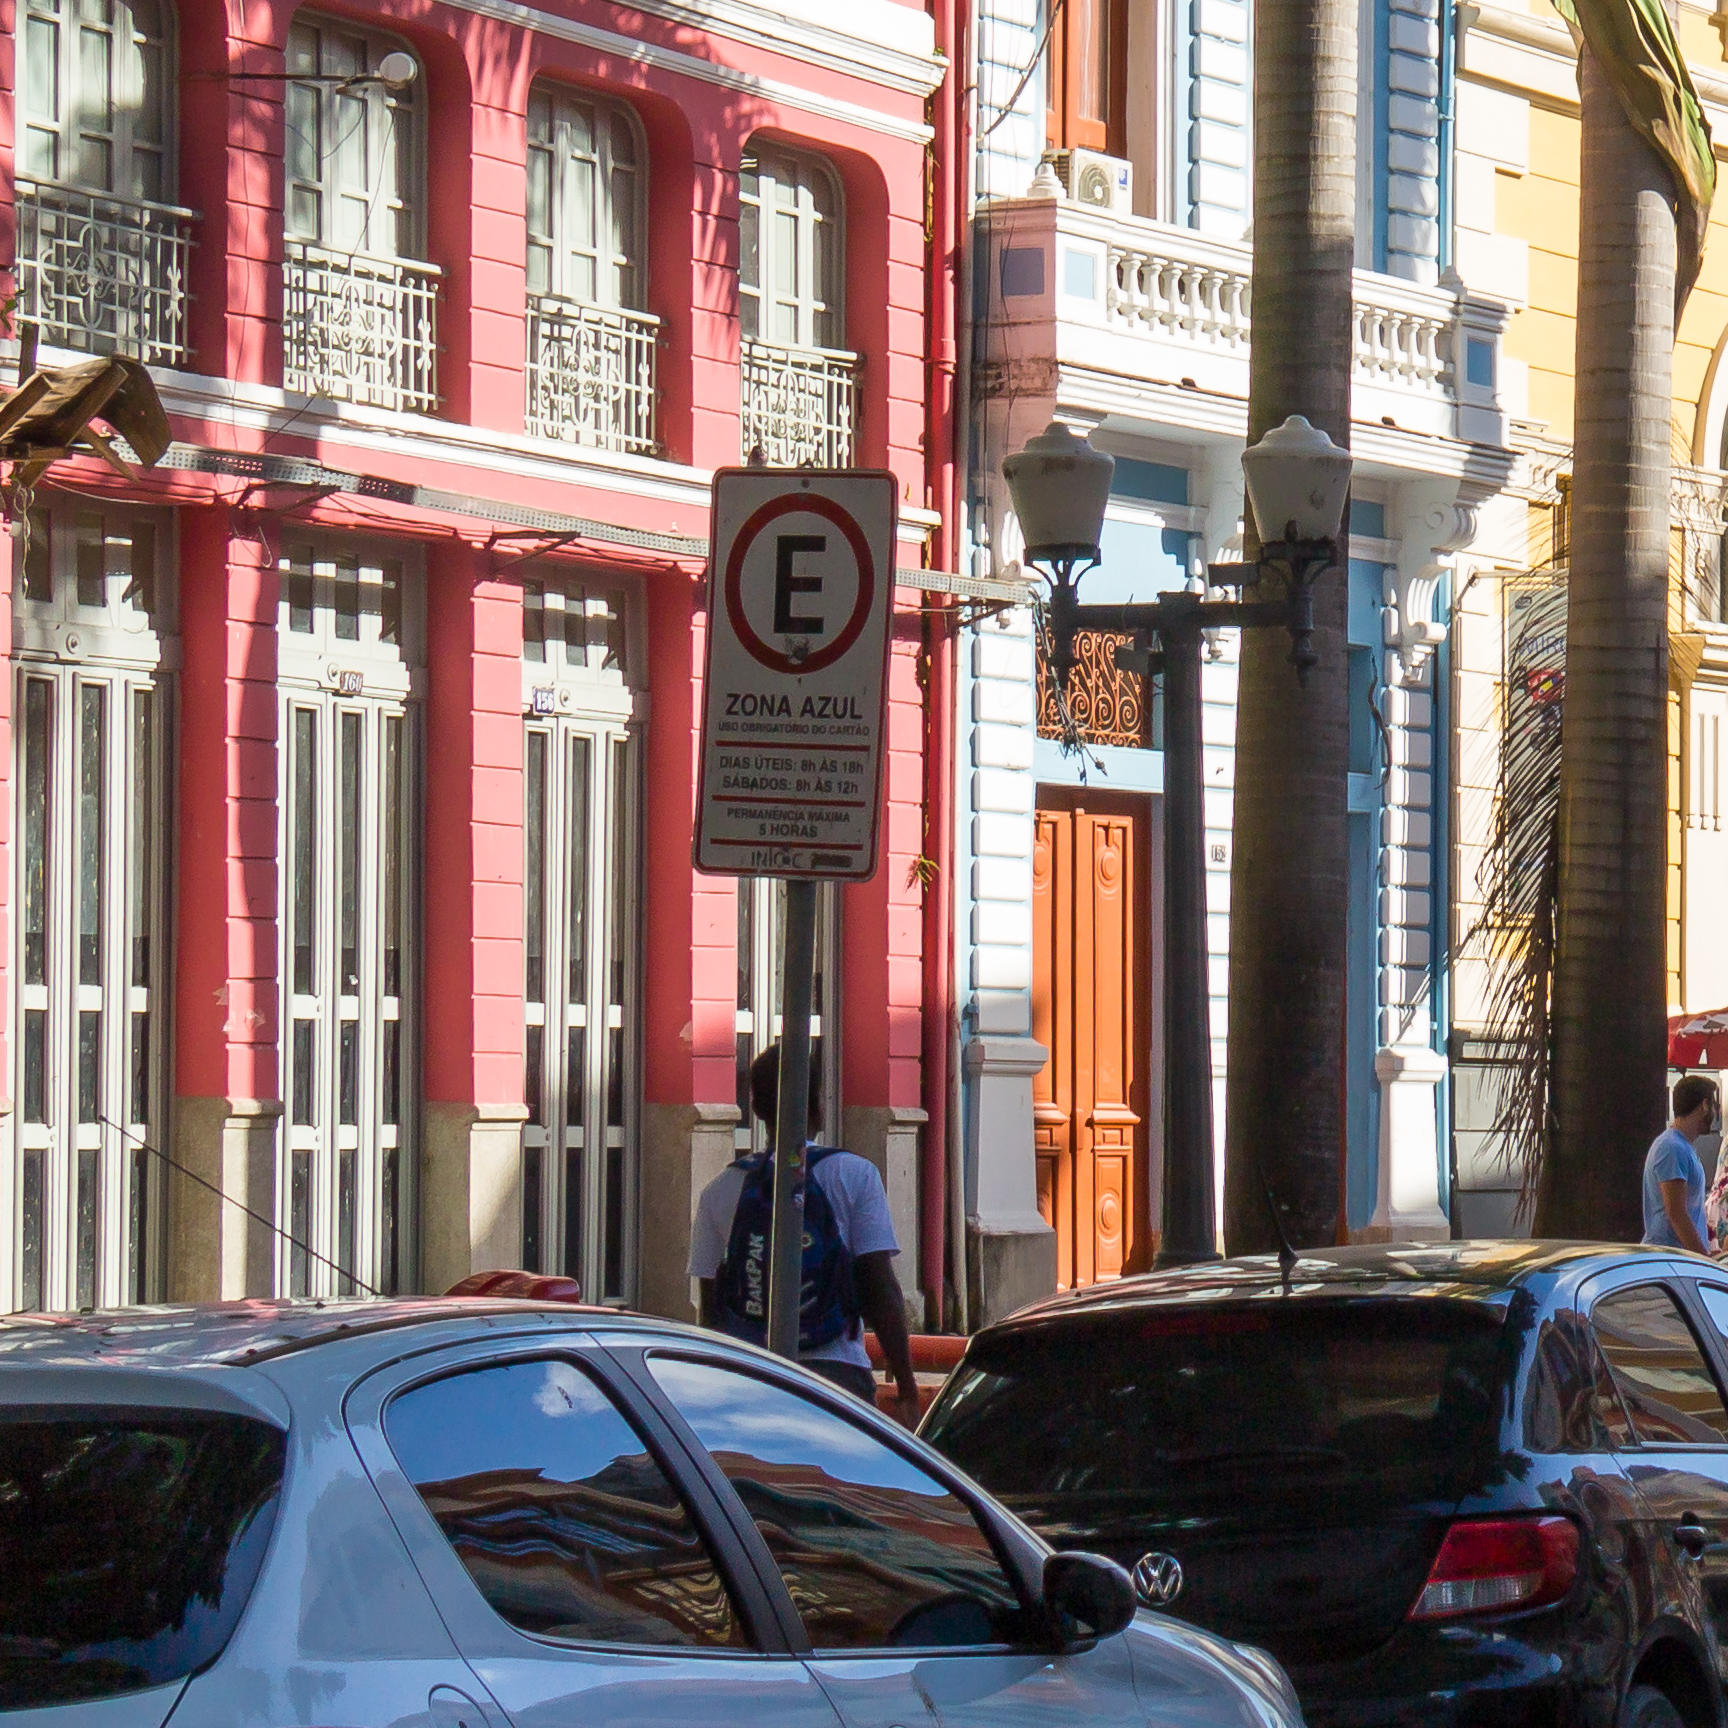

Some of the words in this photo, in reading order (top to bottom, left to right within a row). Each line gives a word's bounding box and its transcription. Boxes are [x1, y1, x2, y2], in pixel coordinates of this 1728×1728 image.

[773, 535, 827, 635] E
[725, 693, 792, 718] ZONA
[799, 696, 863, 719] AZUL
[718, 722, 738, 732] USO
[741, 722, 809, 734] OBRIGATÓRIO
[812, 724, 826, 735] DO
[719, 756, 750, 770] DIAS
[754, 754, 797, 771] ÚTEIS:
[801, 759, 816, 772] 8h
[820, 758, 837, 772] ÀS
[843, 762, 864, 774] 18h
[722, 774, 791, 791] SÁBADOS:
[796, 780, 810, 792] 8h
[814, 777, 832, 793] ÀS
[837, 782, 858, 794] 12h
[727, 806, 805, 822] PERMANÊNCIA
[759, 824, 766, 835] 5
[770, 824, 818, 838] HORAS
